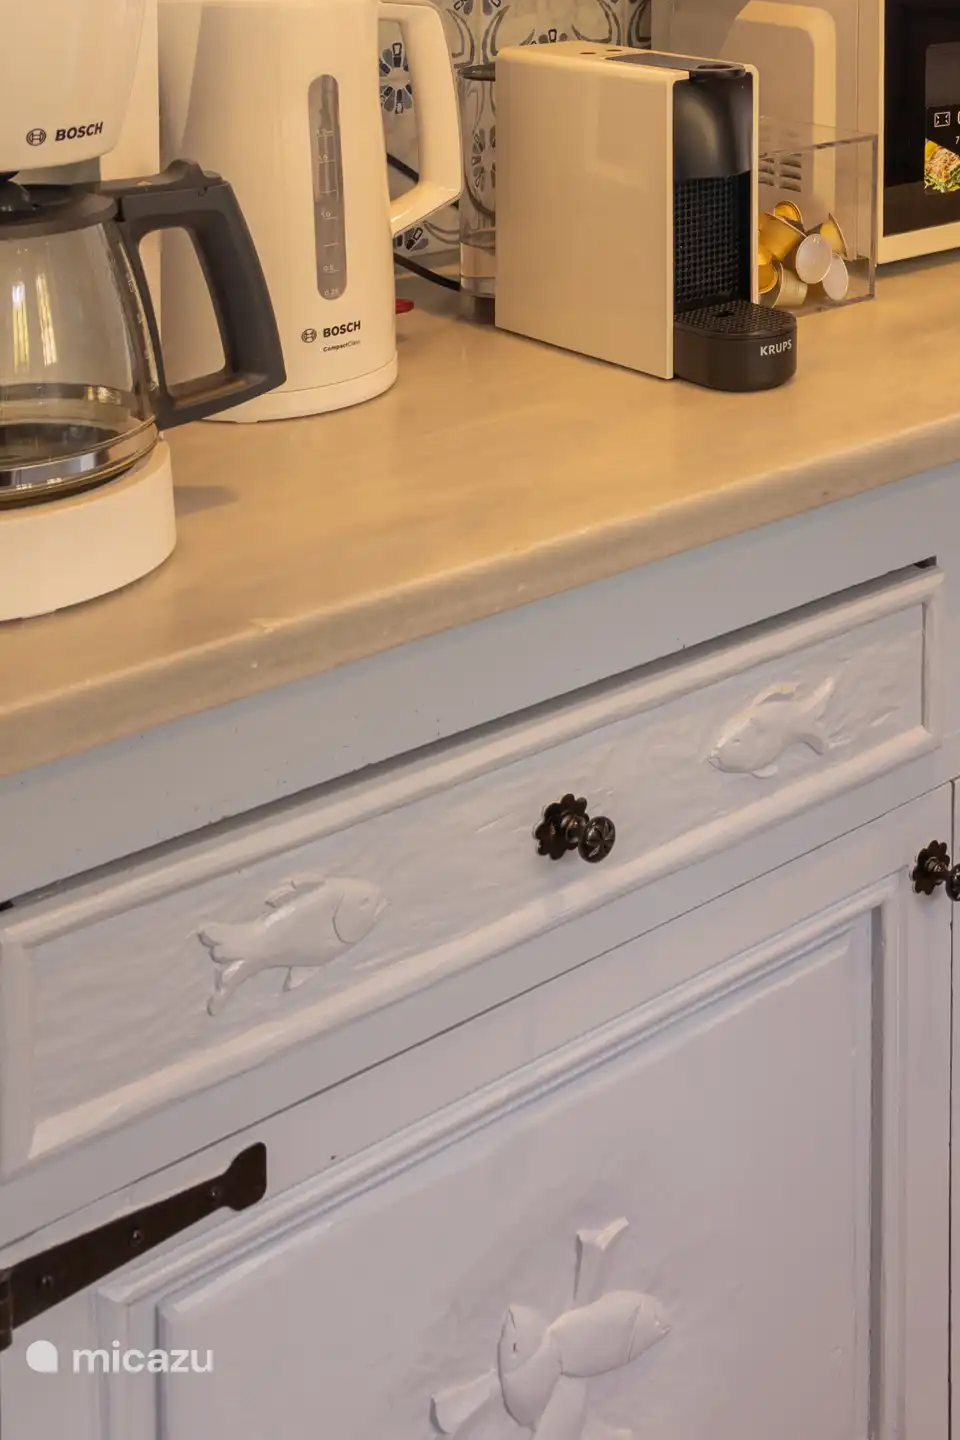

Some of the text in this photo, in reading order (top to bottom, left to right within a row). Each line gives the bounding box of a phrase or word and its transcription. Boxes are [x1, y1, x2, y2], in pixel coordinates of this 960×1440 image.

[55, 121, 104, 142] BOSCH
[955, 136, 960, 145] 7
[323, 319, 361, 338] BOSCH
[760, 339, 792, 356] KRUPS
